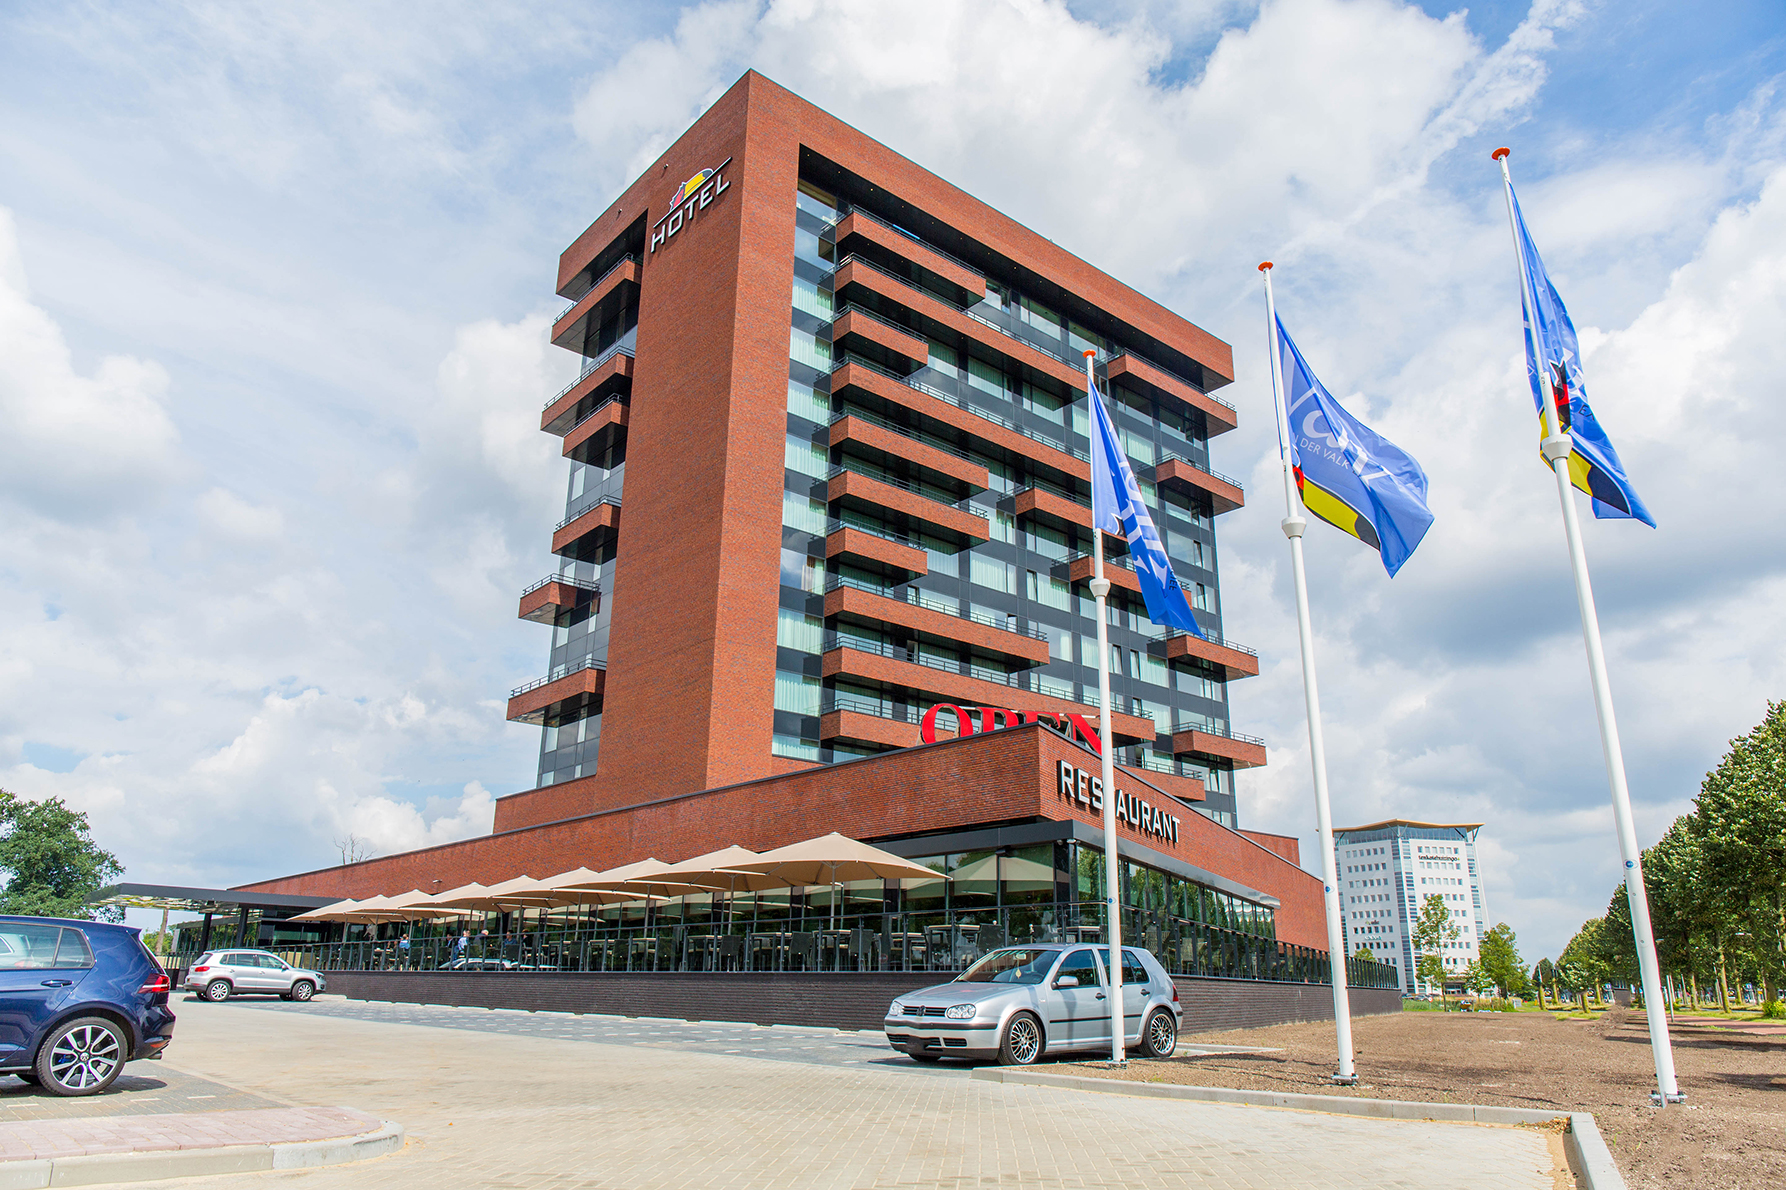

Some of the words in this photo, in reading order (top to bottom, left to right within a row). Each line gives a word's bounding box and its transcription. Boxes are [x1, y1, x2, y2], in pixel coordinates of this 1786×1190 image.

[651, 174, 730, 253] HOTEL
[1300, 437, 1320, 455] DER
[1323, 448, 1349, 470] VALK
[1058, 760, 1180, 843] RESAURANT
